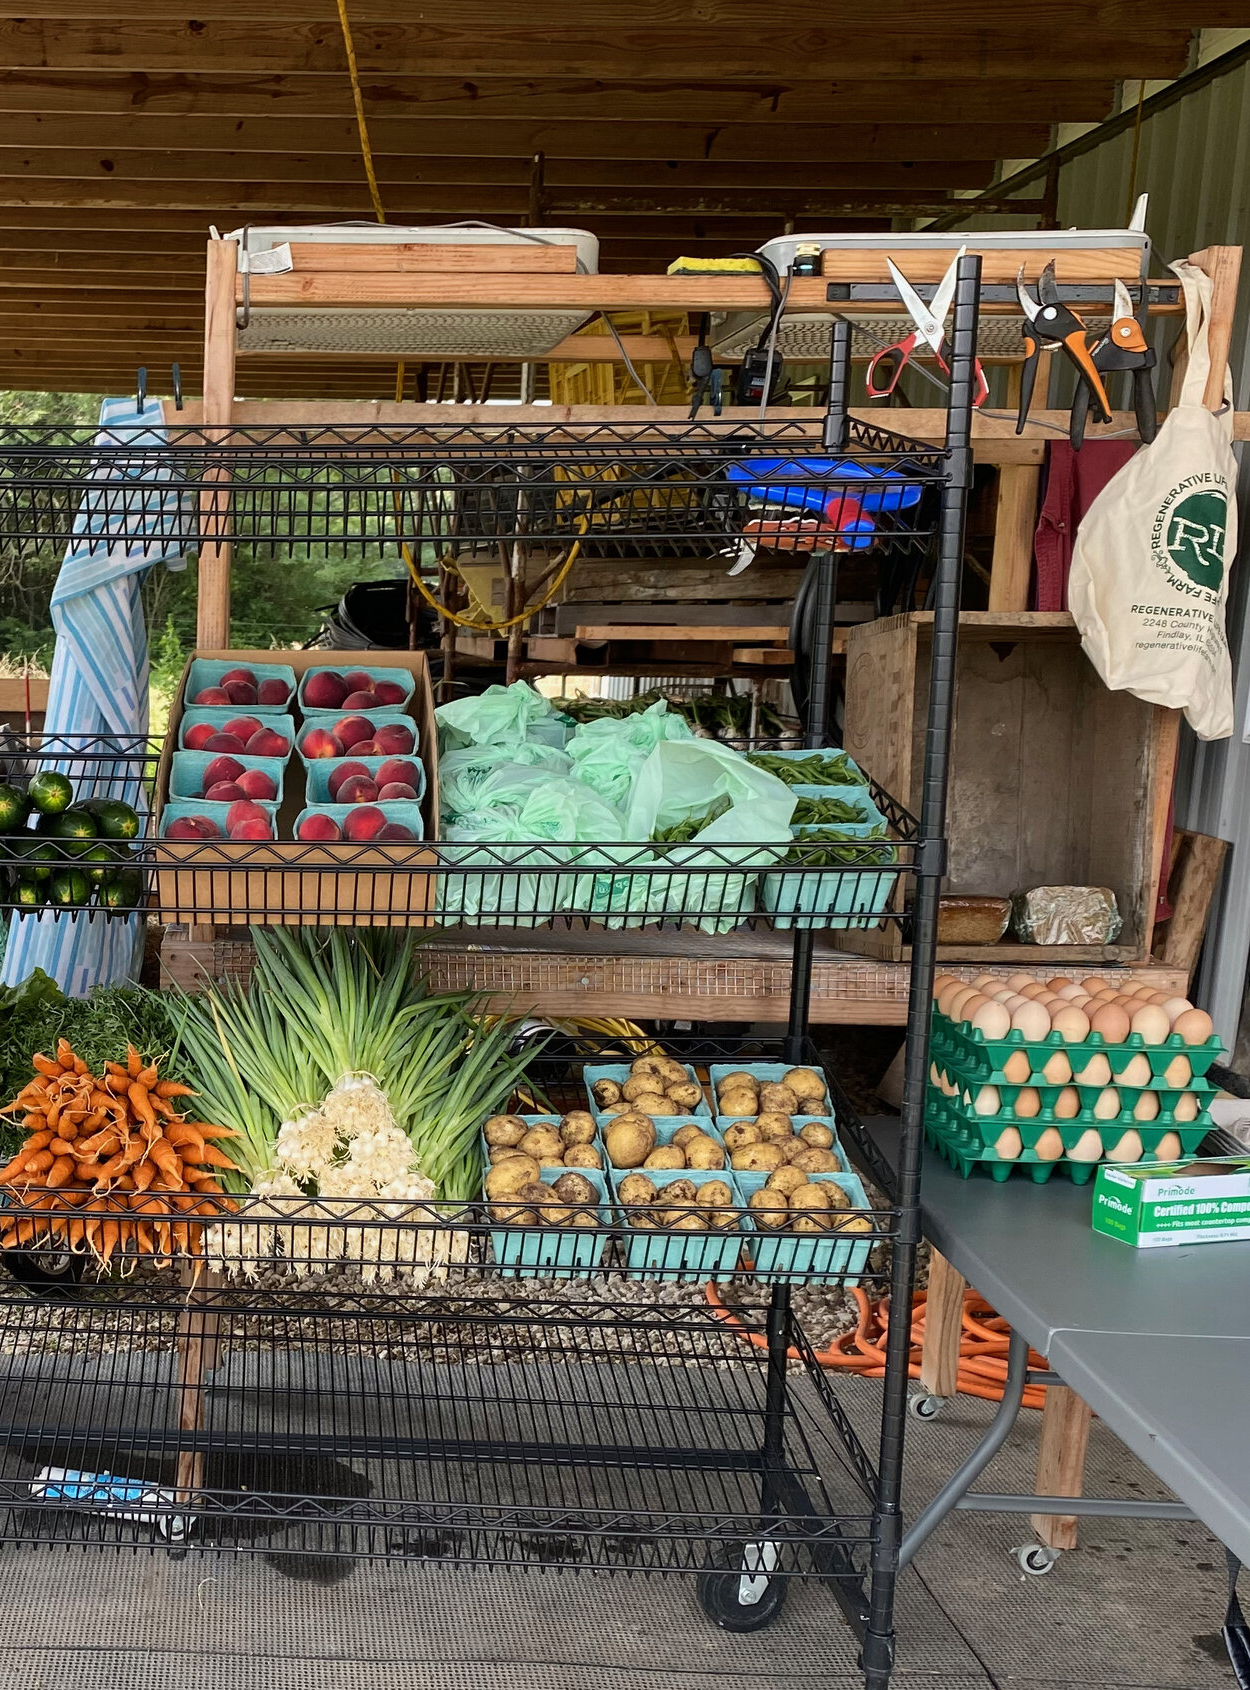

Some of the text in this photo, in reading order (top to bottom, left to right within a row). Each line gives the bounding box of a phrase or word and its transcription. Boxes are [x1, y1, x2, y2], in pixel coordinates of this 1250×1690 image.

[1151, 472, 1212, 550] REGENERATIVE
[1166, 575, 1202, 599] FARM
[1130, 604, 1214, 623] REGENERATIVE
[1142, 617, 1205, 633] 2248 County
[1156, 630, 1205, 643] Findlay, IL
[1158, 1184, 1196, 1196] Primode
[1098, 1193, 1133, 1216] Primode
[1153, 1203, 1195, 1218] Certified
[1196, 1202, 1220, 1215] 100%
